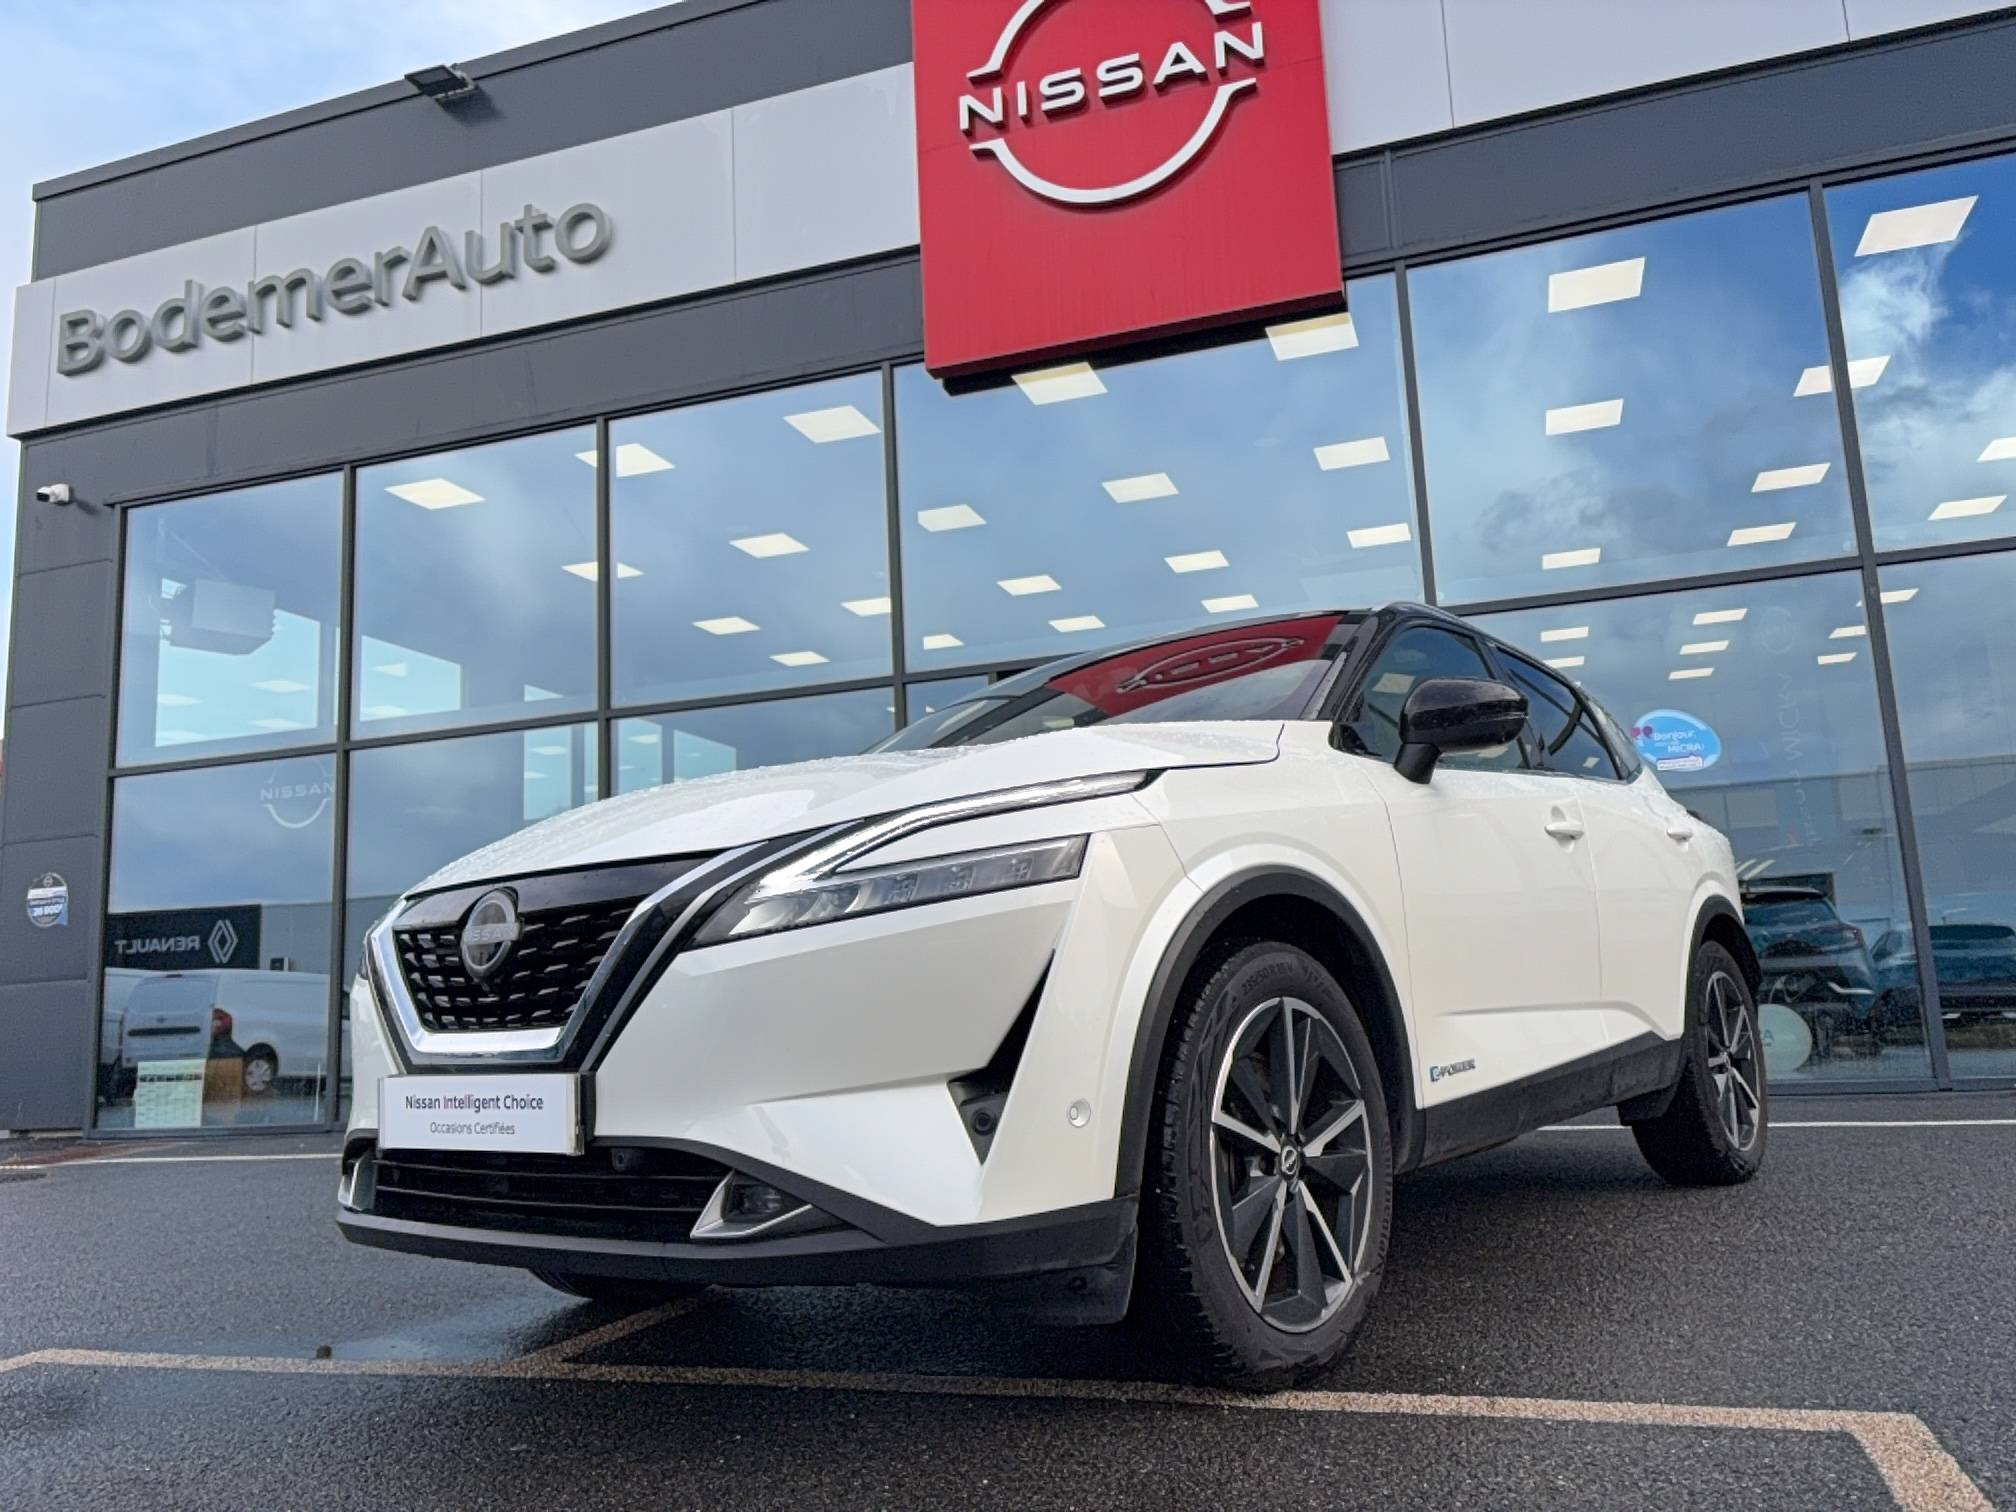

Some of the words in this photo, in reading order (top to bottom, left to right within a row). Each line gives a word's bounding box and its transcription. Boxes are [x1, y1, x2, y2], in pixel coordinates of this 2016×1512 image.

[958, 21, 1265, 135] NISSAN
[56, 202, 611, 376] BodemerAuto
[259, 782, 336, 801] NISSAN
[405, 1095, 441, 1110] Nissan
[443, 1094, 501, 1113] Intelligent
[503, 1094, 545, 1111] Choice
[430, 1121, 473, 1135] Occasions
[474, 1121, 515, 1136] Certifiées
